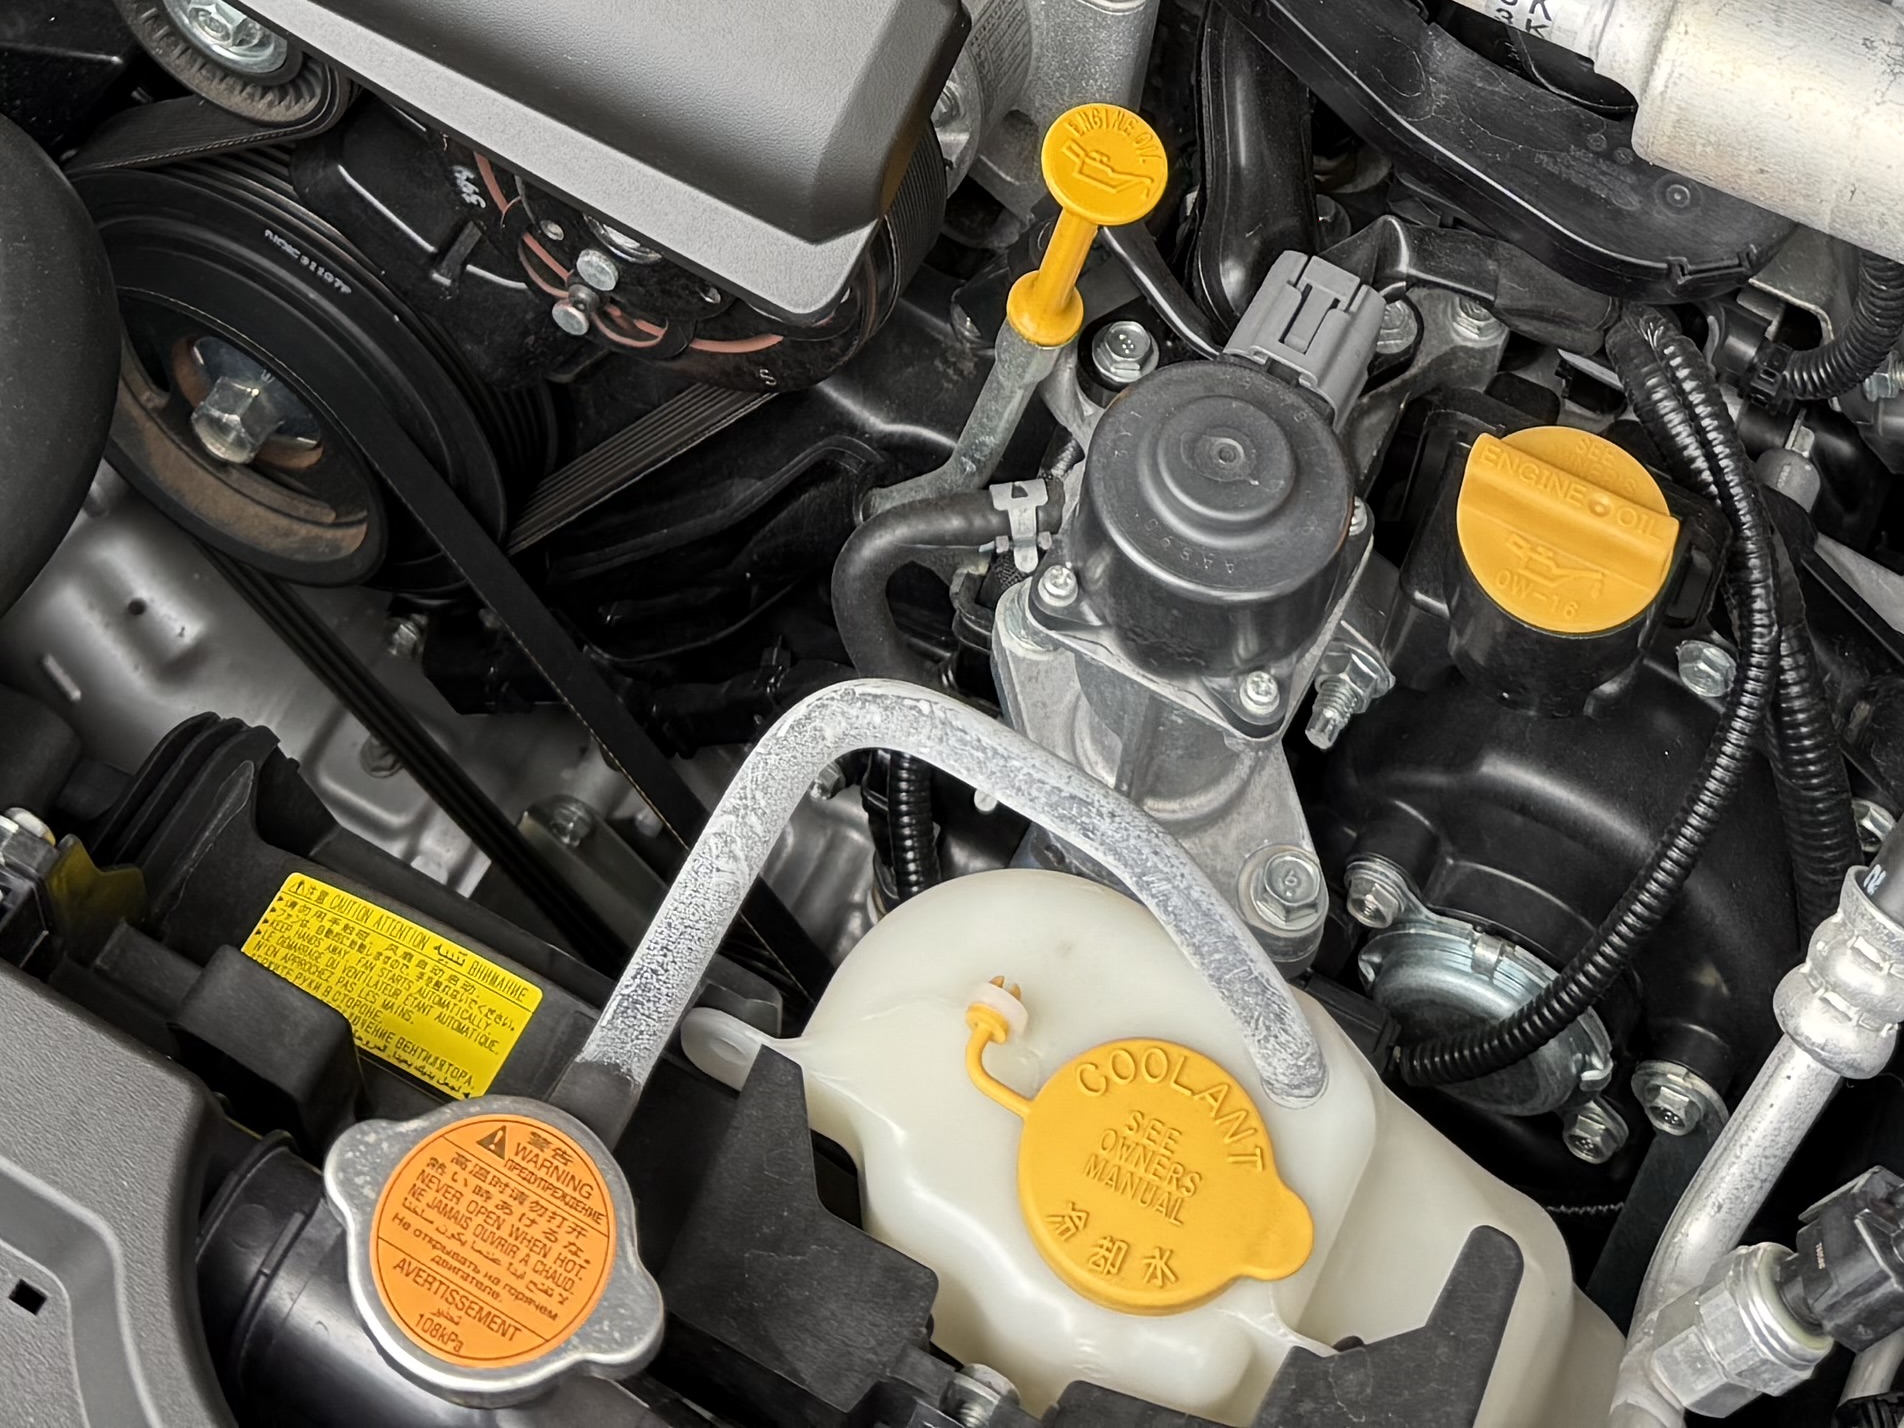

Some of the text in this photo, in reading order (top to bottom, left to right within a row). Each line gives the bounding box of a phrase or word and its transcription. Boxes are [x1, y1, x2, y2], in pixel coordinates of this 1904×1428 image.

[1064, 107, 1139, 138] ENGINE
[1477, 443, 1667, 542] ENGINE OIL
[1497, 569, 1580, 621] 0W-16
[371, 912, 431, 951] ATTENTION
[333, 974, 357, 994] PAS
[357, 985, 380, 1005] LES
[375, 965, 415, 993] STARTS
[1074, 1046, 1266, 1174] COOLANT
[1126, 1109, 1183, 1157] SEE
[502, 1156, 609, 1226] ПРЕДУПРЕЖДЕНИЕ
[513, 1140, 594, 1201] WARNING
[1083, 1154, 1185, 1227] MANUAL
[1099, 1127, 1203, 1199] OWNERS
[390, 1212, 413, 1232] Не
[410, 1227, 483, 1276] открывать
[482, 1270, 501, 1287] на
[406, 1182, 576, 1296] NE JAMAIS OUVRIR CHAUD.
[414, 1167, 588, 1281] NEVER OPEN WHEN HOT.
[1046, 1200, 1181, 1290] 冷却水
[391, 1256, 523, 1342] AVERTISSEMENT
[414, 1312, 464, 1356] 108kPa
